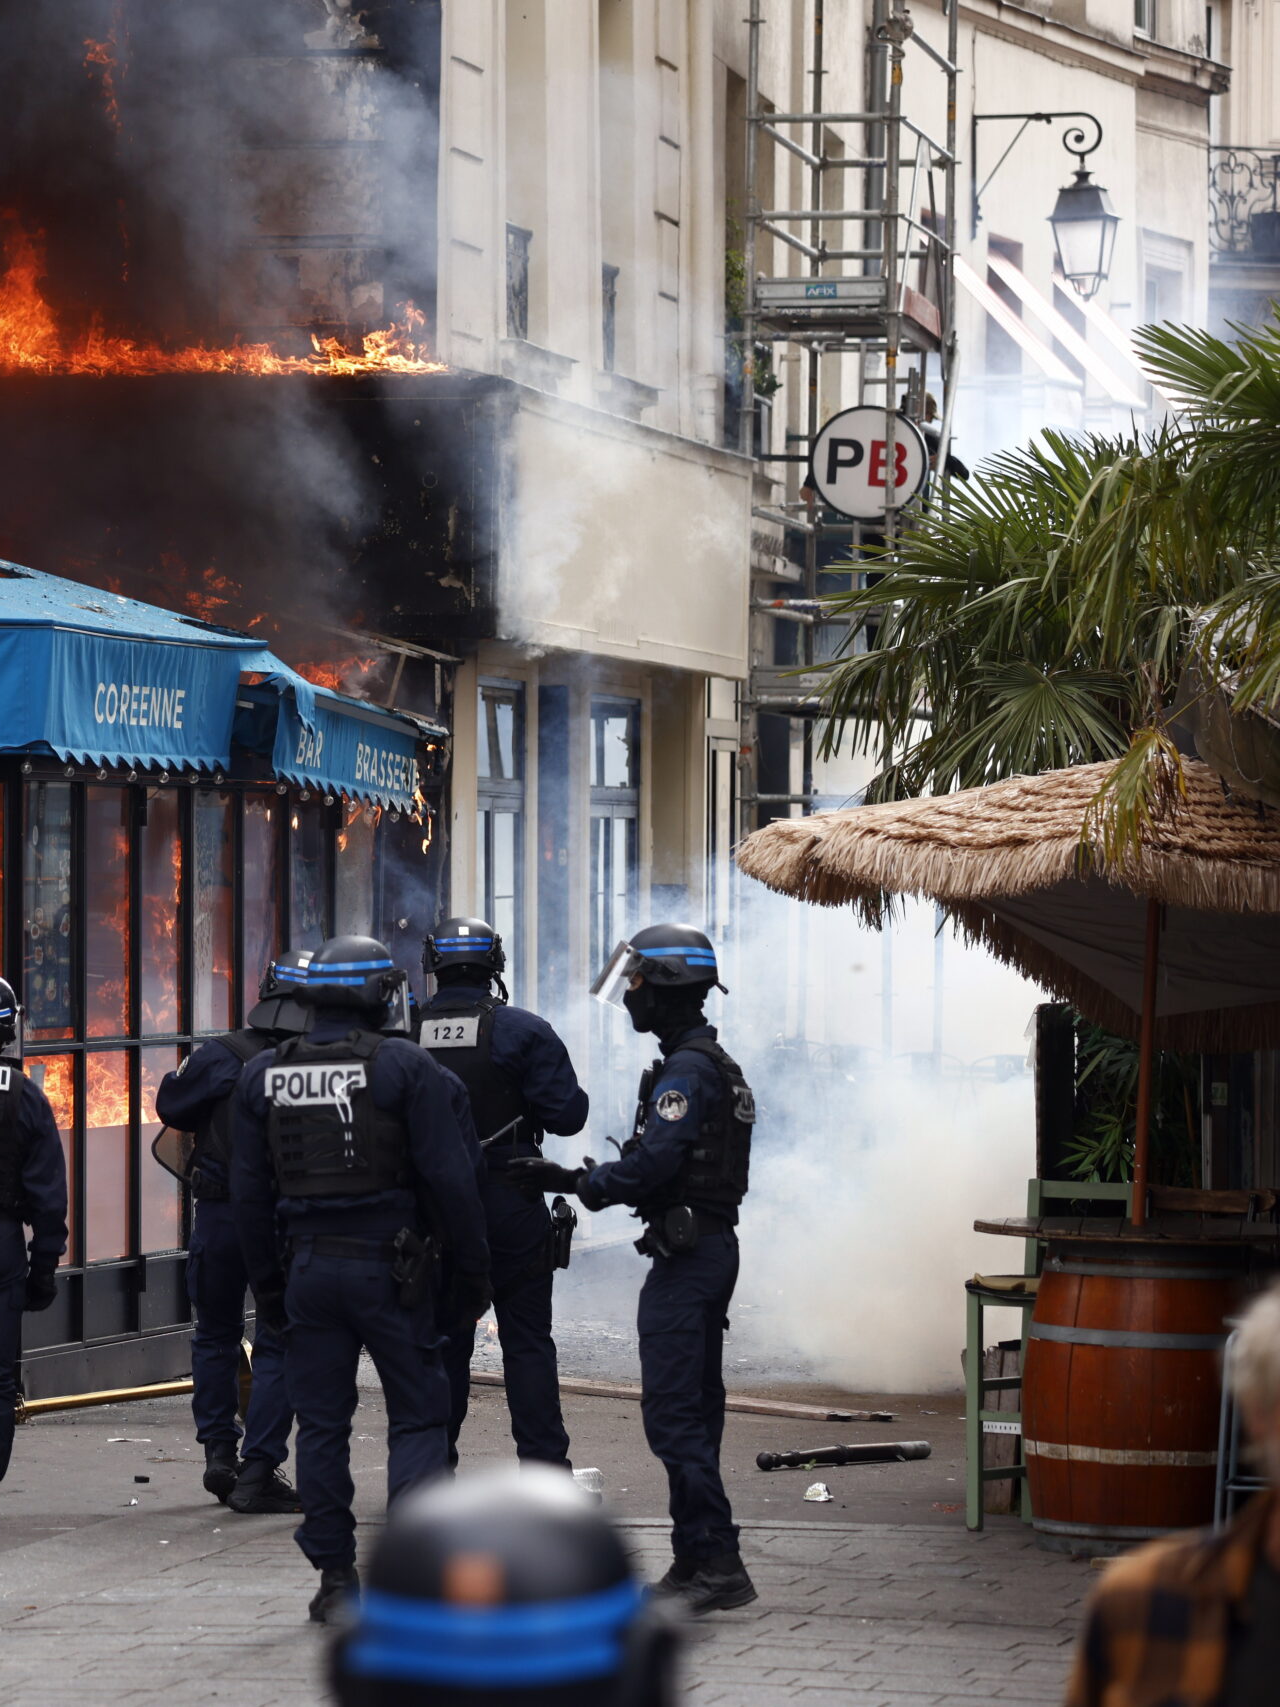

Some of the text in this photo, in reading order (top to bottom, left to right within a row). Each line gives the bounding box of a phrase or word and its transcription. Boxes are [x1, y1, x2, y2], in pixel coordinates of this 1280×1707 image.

[807, 286, 835, 297] AFIX
[825, 437, 909, 489] PB
[94, 682, 186, 729] COREENNE
[295, 726, 324, 769] BAR
[272, 1069, 362, 1100] POLICE
